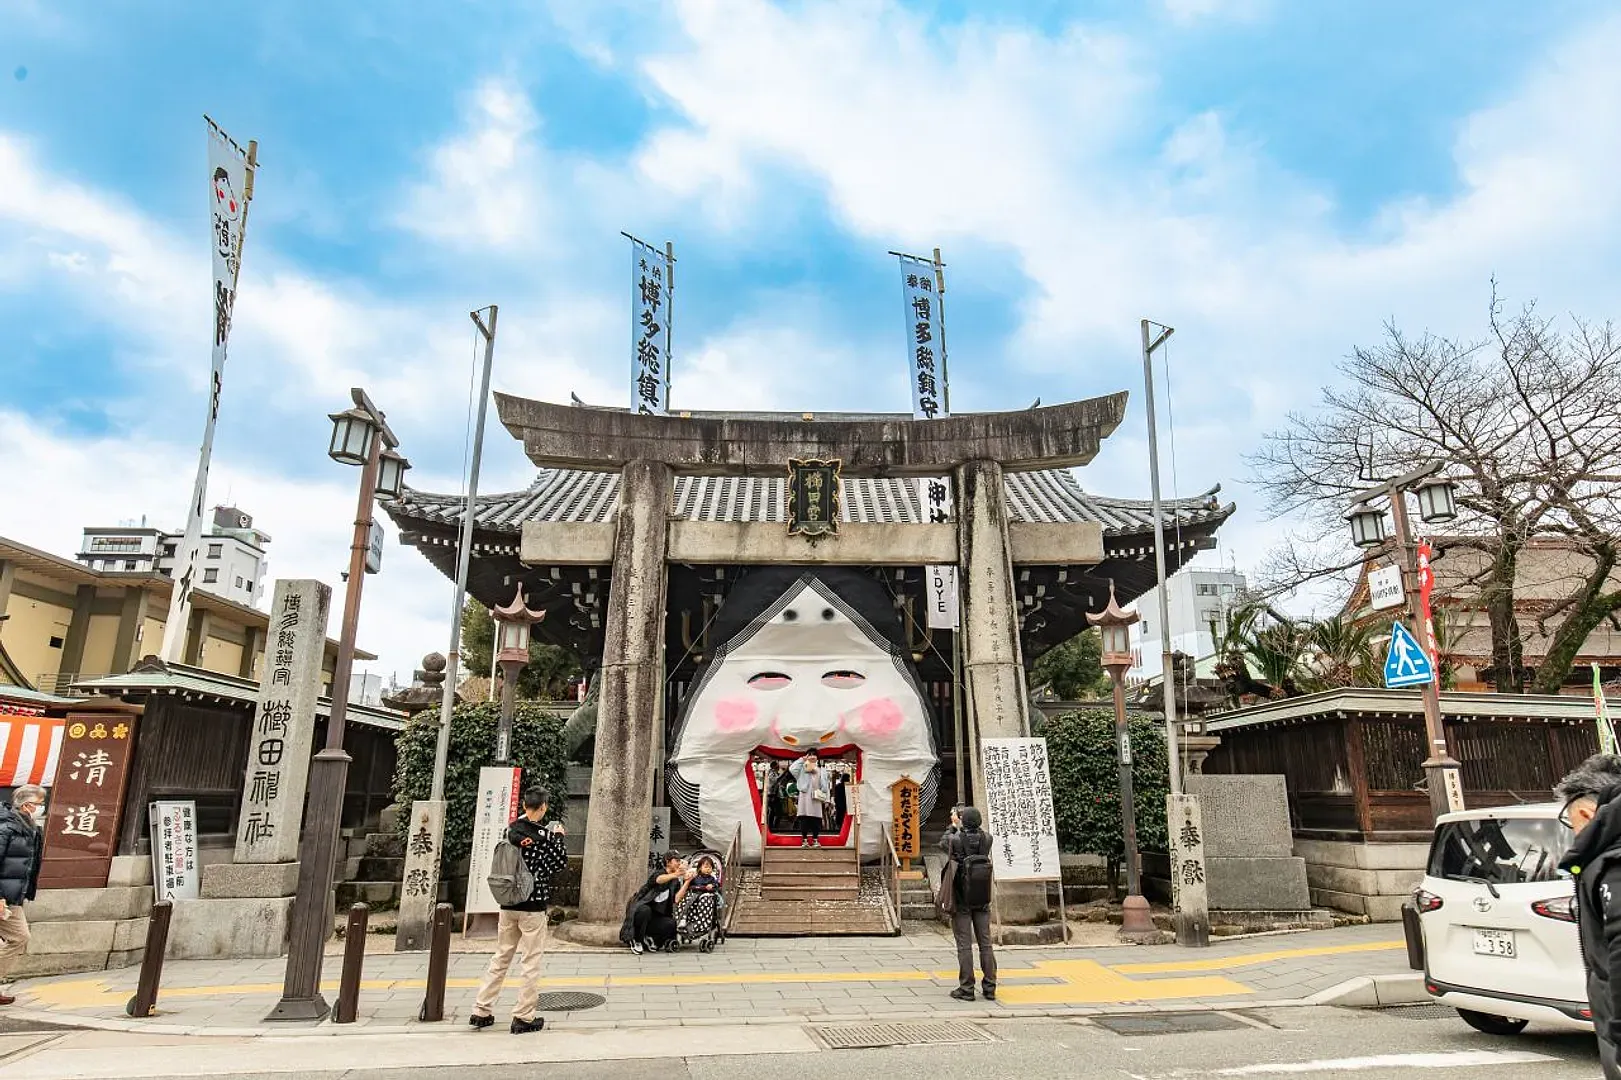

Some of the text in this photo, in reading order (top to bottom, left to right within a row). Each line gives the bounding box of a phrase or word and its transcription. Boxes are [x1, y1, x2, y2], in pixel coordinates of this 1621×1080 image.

[933, 577, 947, 613] DYE
[61, 748, 113, 838] 清道
[900, 786, 913, 853] おたふくわた
